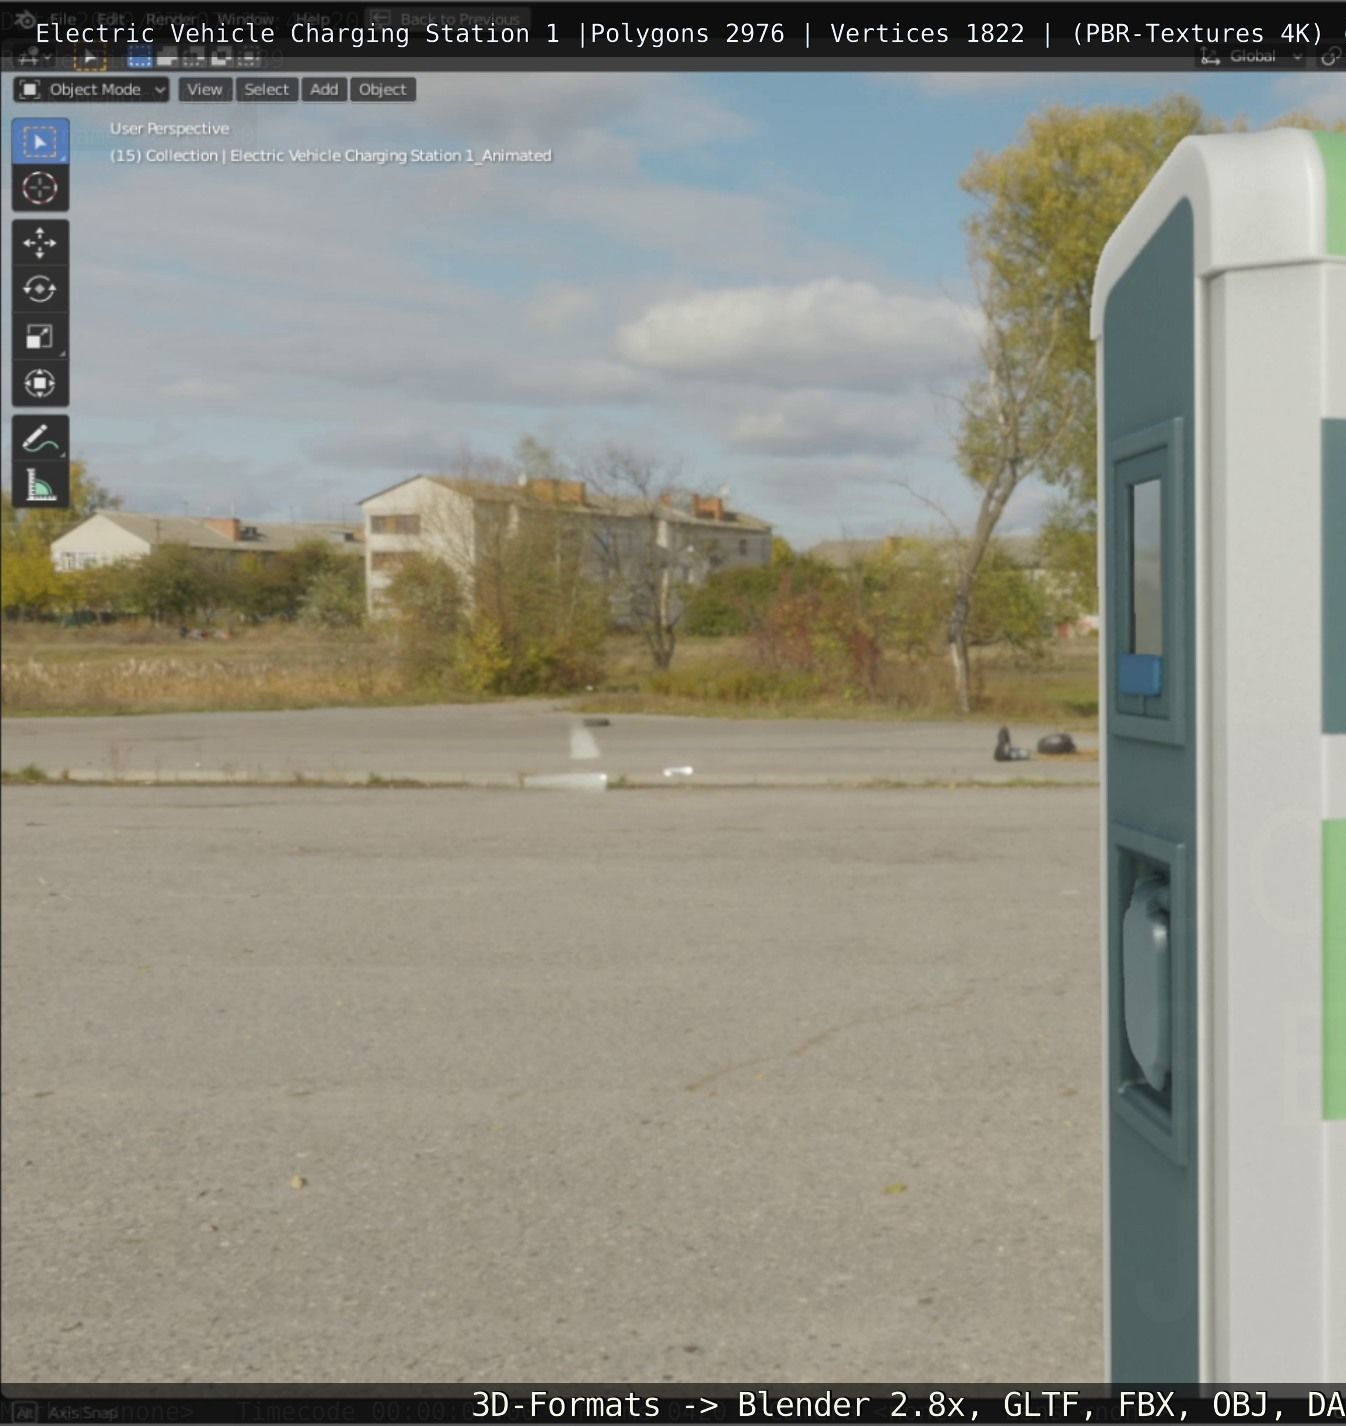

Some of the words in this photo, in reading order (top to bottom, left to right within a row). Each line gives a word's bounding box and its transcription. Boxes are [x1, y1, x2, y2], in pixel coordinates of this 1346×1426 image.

[400, 13, 437, 26] Back
[440, 14, 456, 26] to
[459, 13, 521, 26] Previous
[1230, 47, 1276, 63] Global
[50, 82, 98, 99] Object
[102, 83, 141, 96] Mode
[187, 83, 223, 96] View
[244, 83, 289, 96] Select
[310, 83, 338, 96] Add
[358, 82, 407, 99] Object
[110, 122, 143, 135] User
[147, 122, 230, 138] Perspective
[110, 149, 142, 164] (15)
[145, 149, 218, 162] Collection
[230, 149, 284, 162] Electric
[288, 149, 341, 162] Vehicle
[344, 149, 407, 165] Charging
[410, 149, 462, 162] Station
[465, 149, 552, 165] 1_Animated
